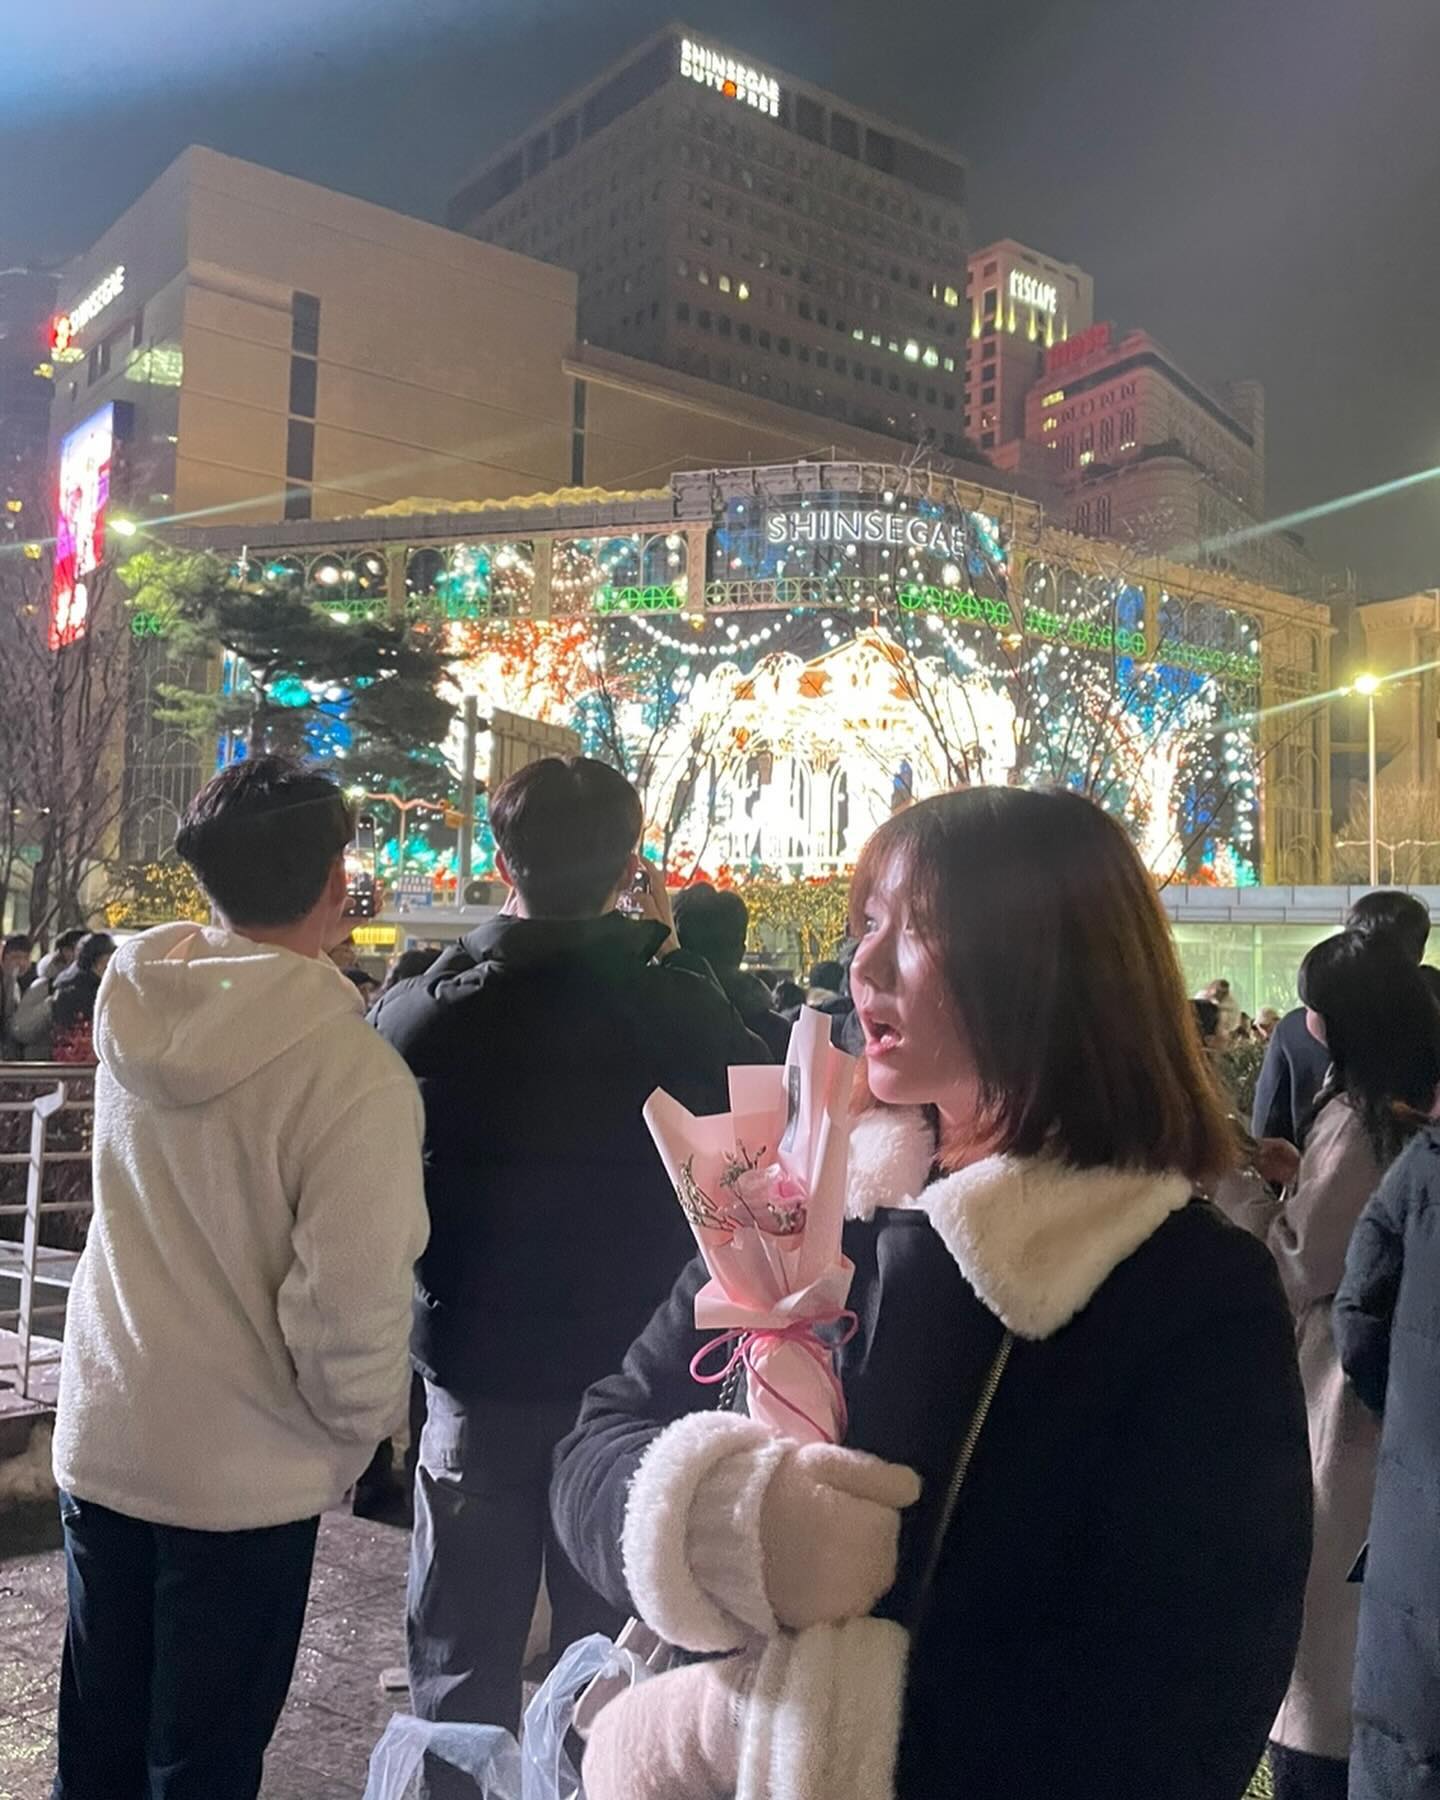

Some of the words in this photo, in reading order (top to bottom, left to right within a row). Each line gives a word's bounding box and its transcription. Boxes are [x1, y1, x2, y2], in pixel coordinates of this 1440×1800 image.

[680, 59, 724, 92] DUTY
[681, 38, 780, 101] SHINSEGAE
[767, 510, 967, 558] SHINSEGAE
